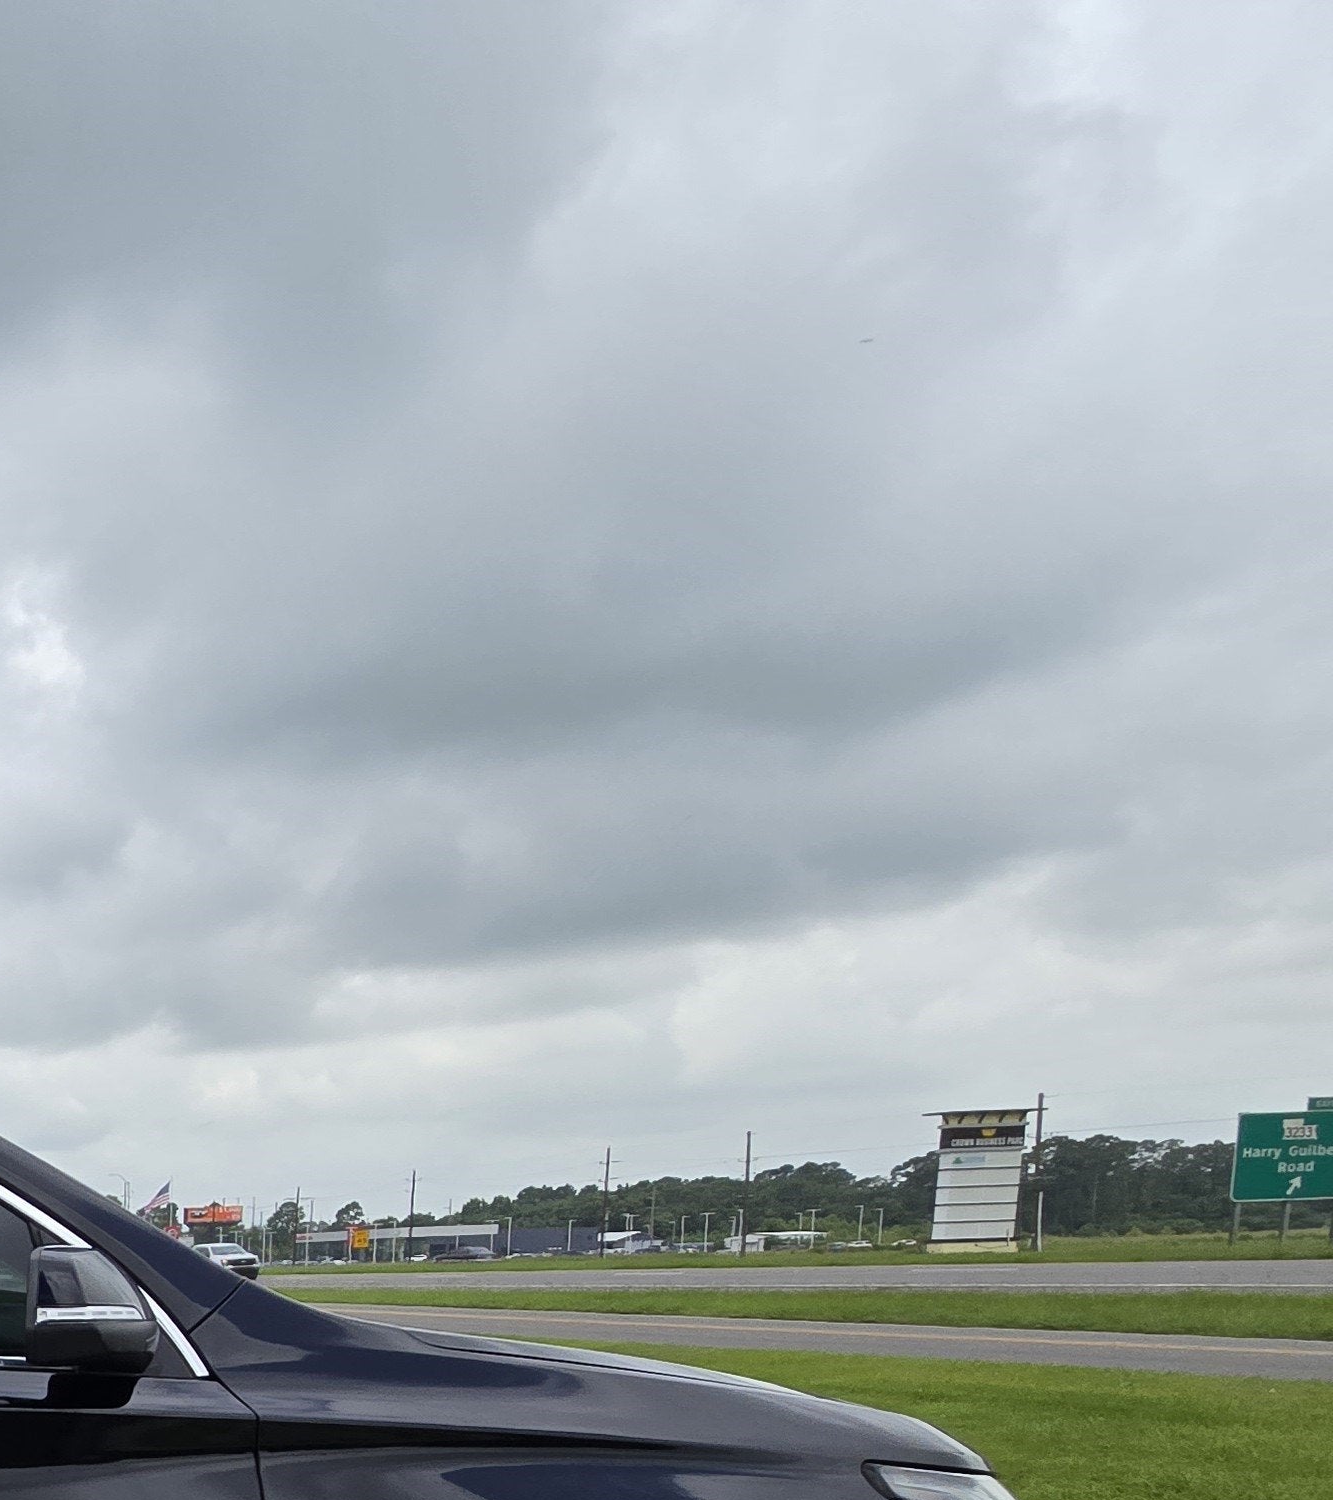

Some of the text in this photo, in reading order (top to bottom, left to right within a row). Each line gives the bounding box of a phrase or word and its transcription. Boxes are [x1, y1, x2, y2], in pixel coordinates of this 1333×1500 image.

[1285, 1126, 1313, 1138] 3233
[1242, 1147, 1282, 1160] Harry
[1277, 1161, 1315, 1173] Road
